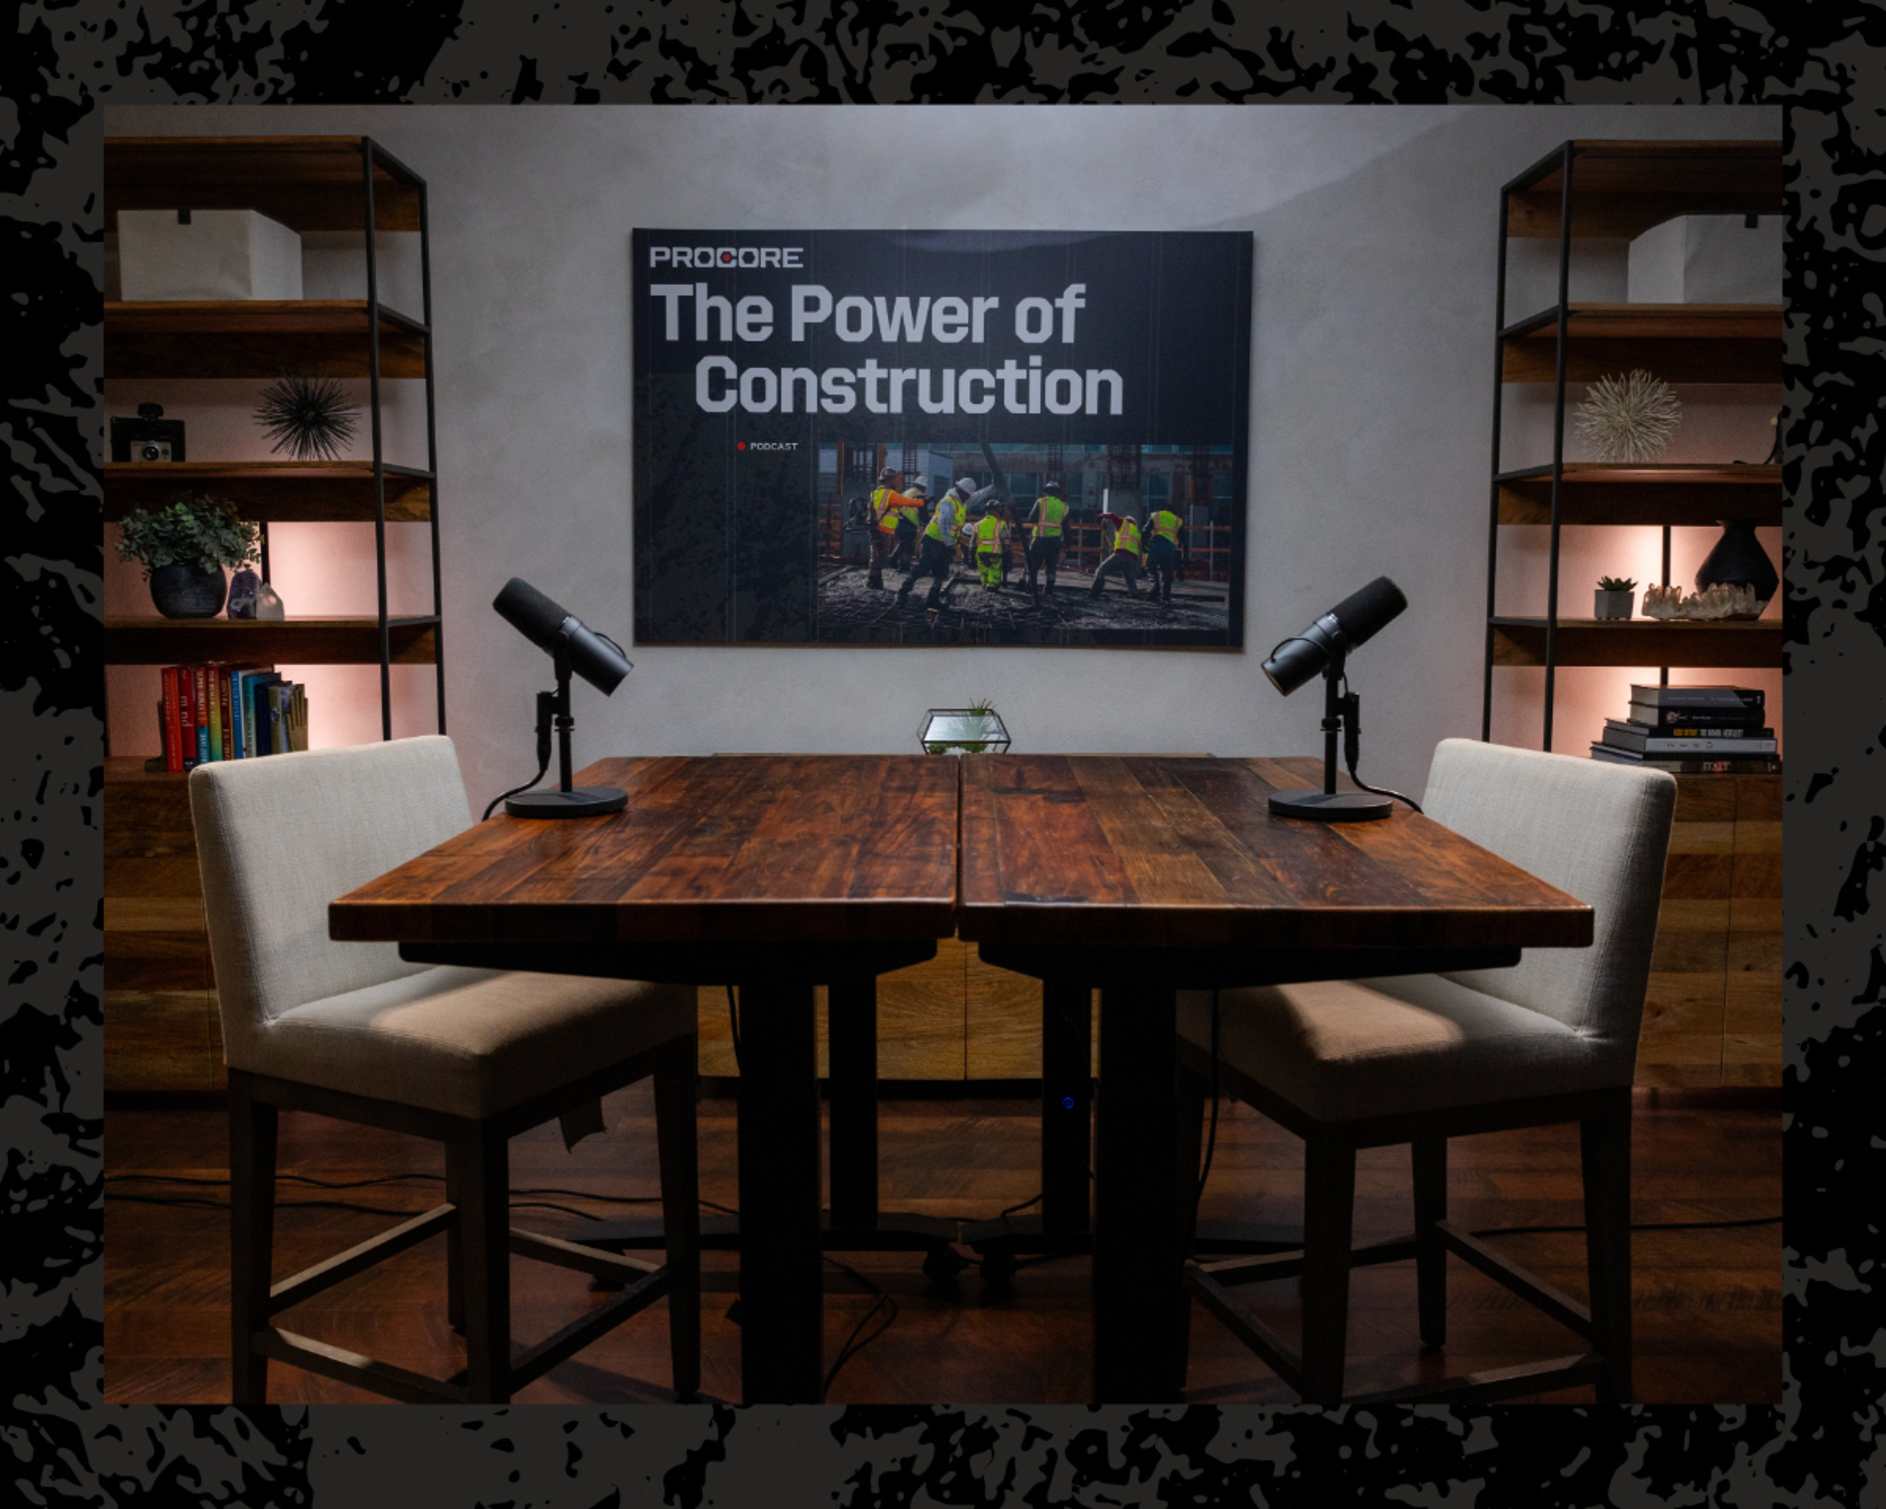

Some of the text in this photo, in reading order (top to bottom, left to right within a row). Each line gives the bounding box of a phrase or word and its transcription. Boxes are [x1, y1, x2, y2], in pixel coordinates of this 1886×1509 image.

[649, 246, 804, 269] PROCORE
[649, 282, 1087, 345] The Power of
[695, 355, 1124, 416] Construction
[750, 442, 798, 451] PODCAST
